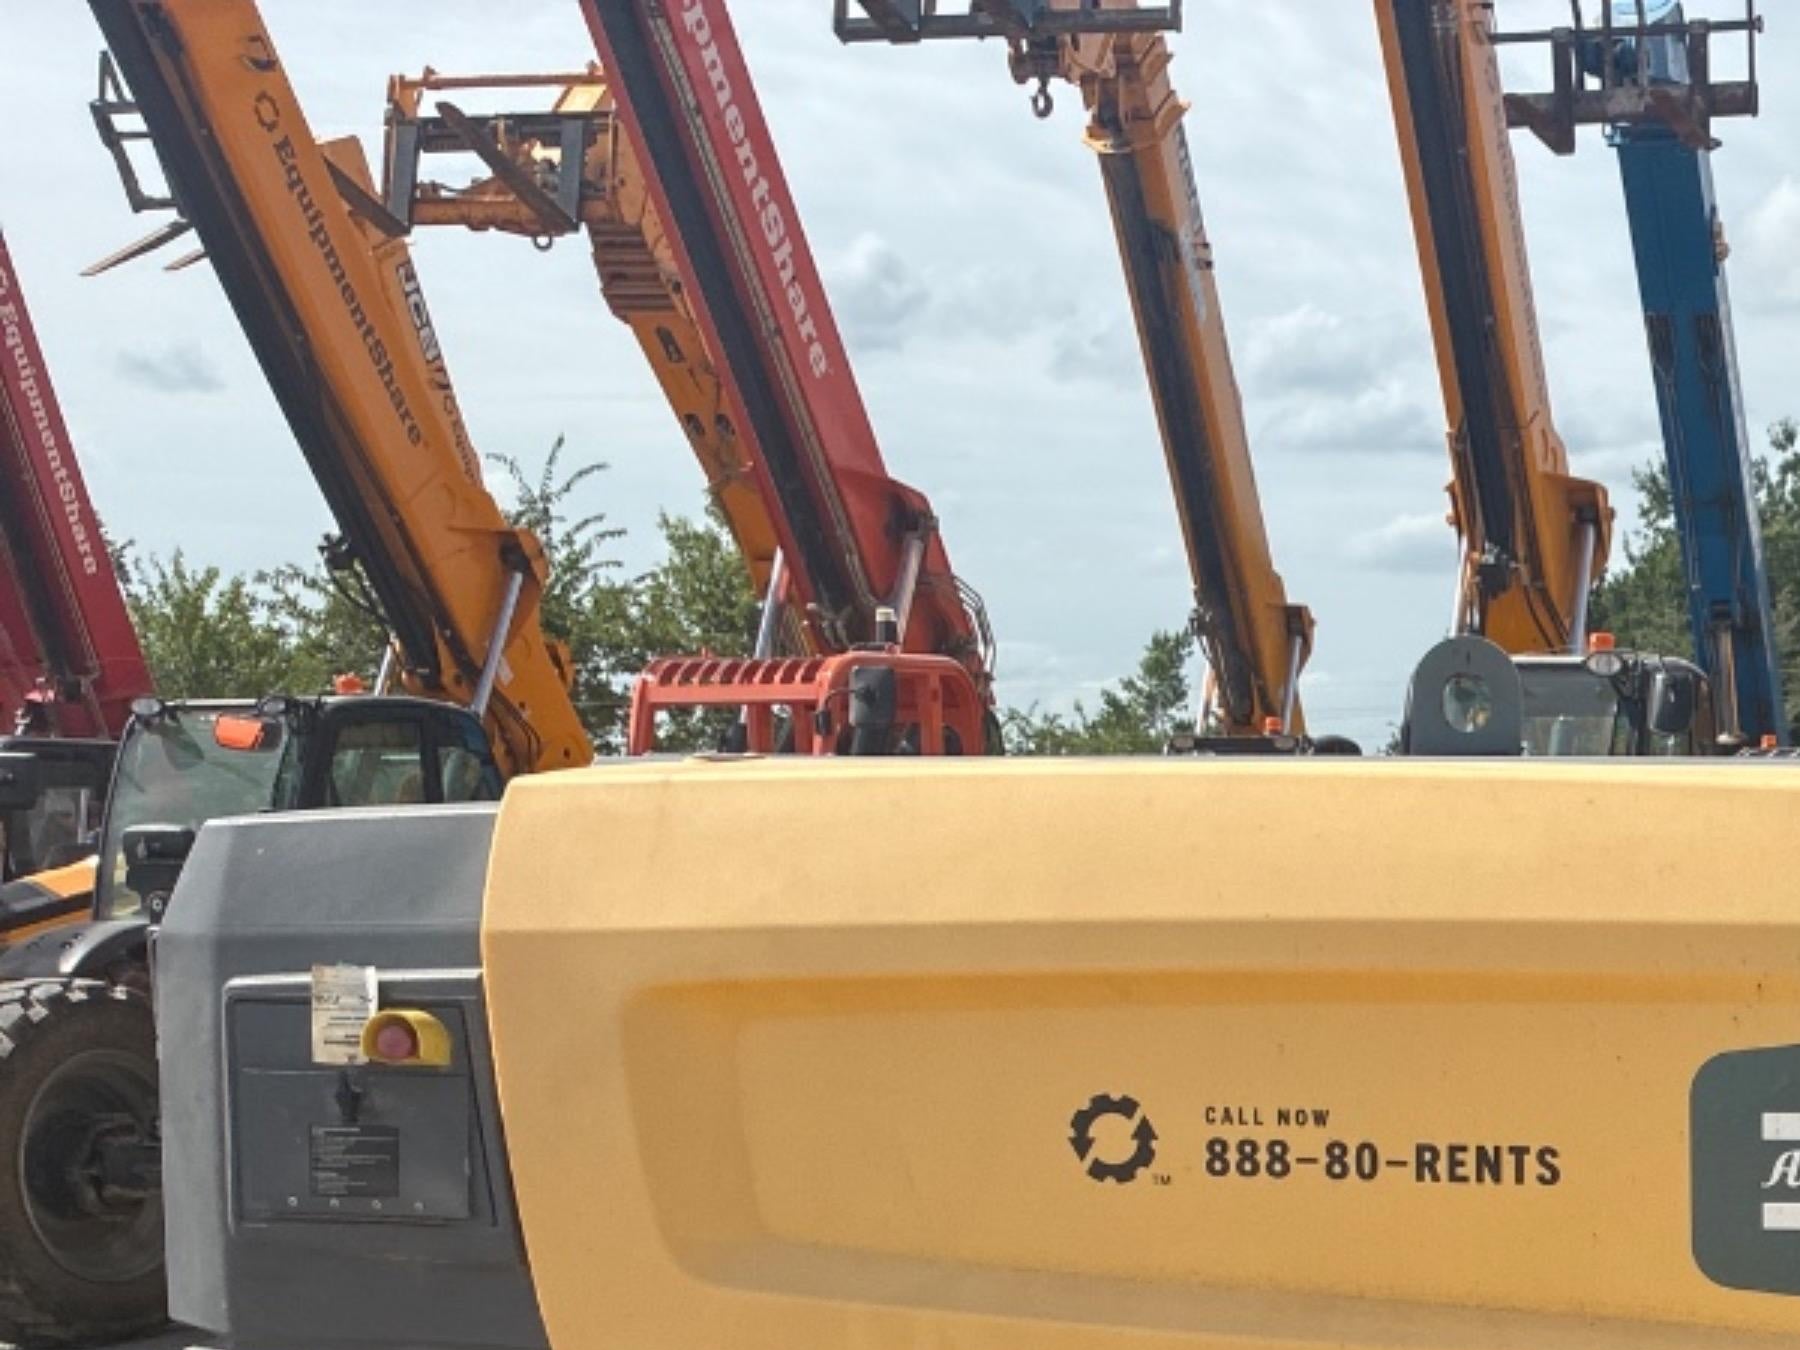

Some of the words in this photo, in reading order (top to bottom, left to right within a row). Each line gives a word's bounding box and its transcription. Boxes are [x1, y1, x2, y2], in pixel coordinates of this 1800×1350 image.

[272, 133, 423, 448] EquipmentShare
[681, 0, 828, 378] pmentShare
[0, 300, 98, 576] EquipmentShare
[1204, 1106, 1264, 1127] CALL
[1276, 1108, 1331, 1128] NOW
[1204, 1136, 1562, 1187] 888-80-RENTS
